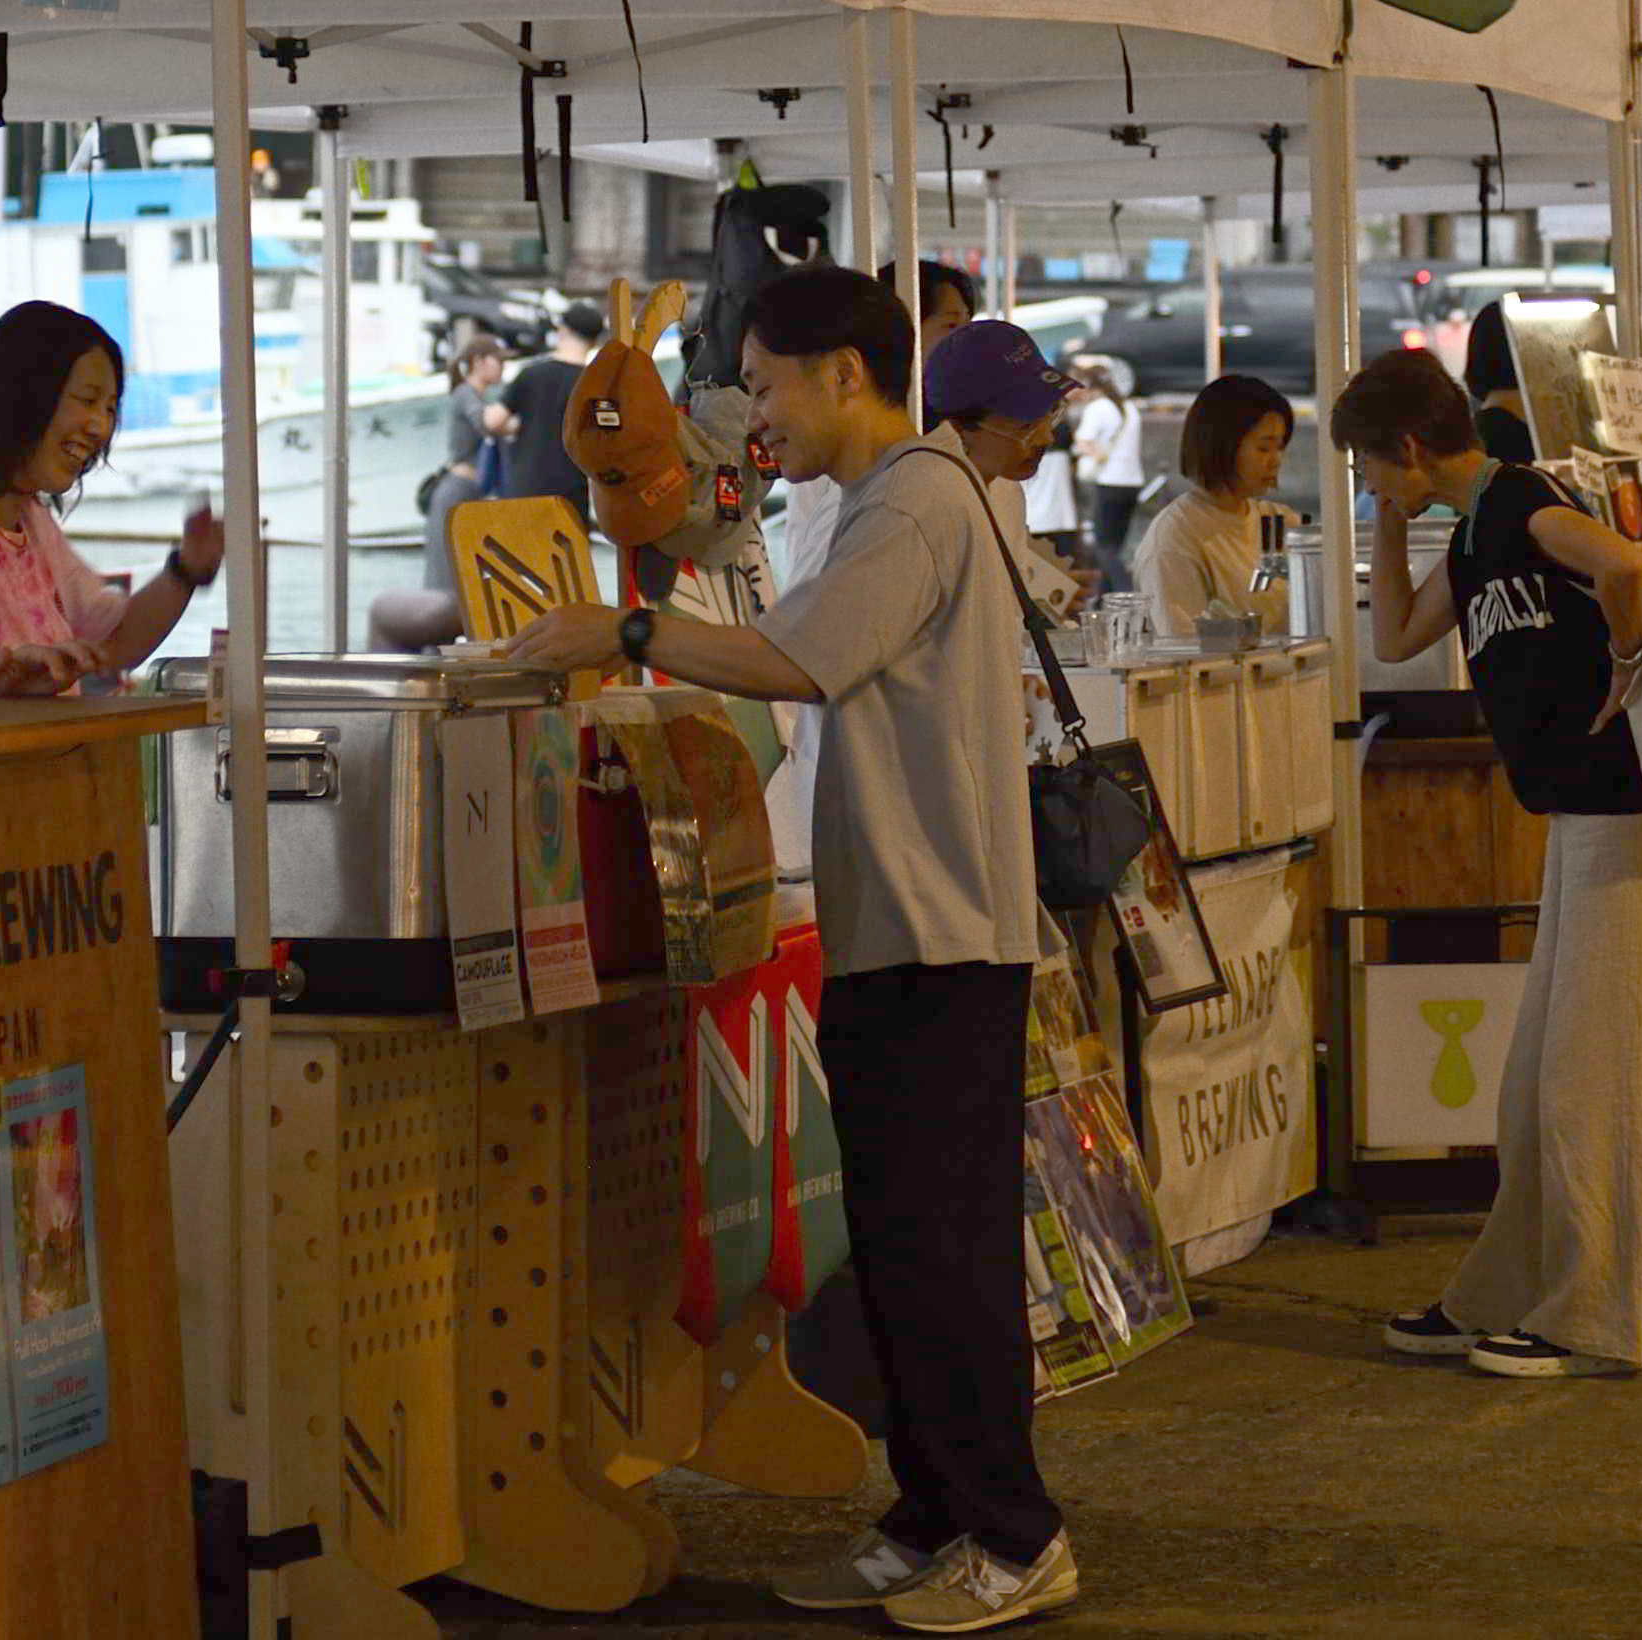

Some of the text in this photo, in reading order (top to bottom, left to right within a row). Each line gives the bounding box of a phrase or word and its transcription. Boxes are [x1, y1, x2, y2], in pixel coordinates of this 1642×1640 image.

[466, 789, 490, 838] N
[696, 990, 768, 1167] N
[1177, 1063, 1289, 1169] BREWING
